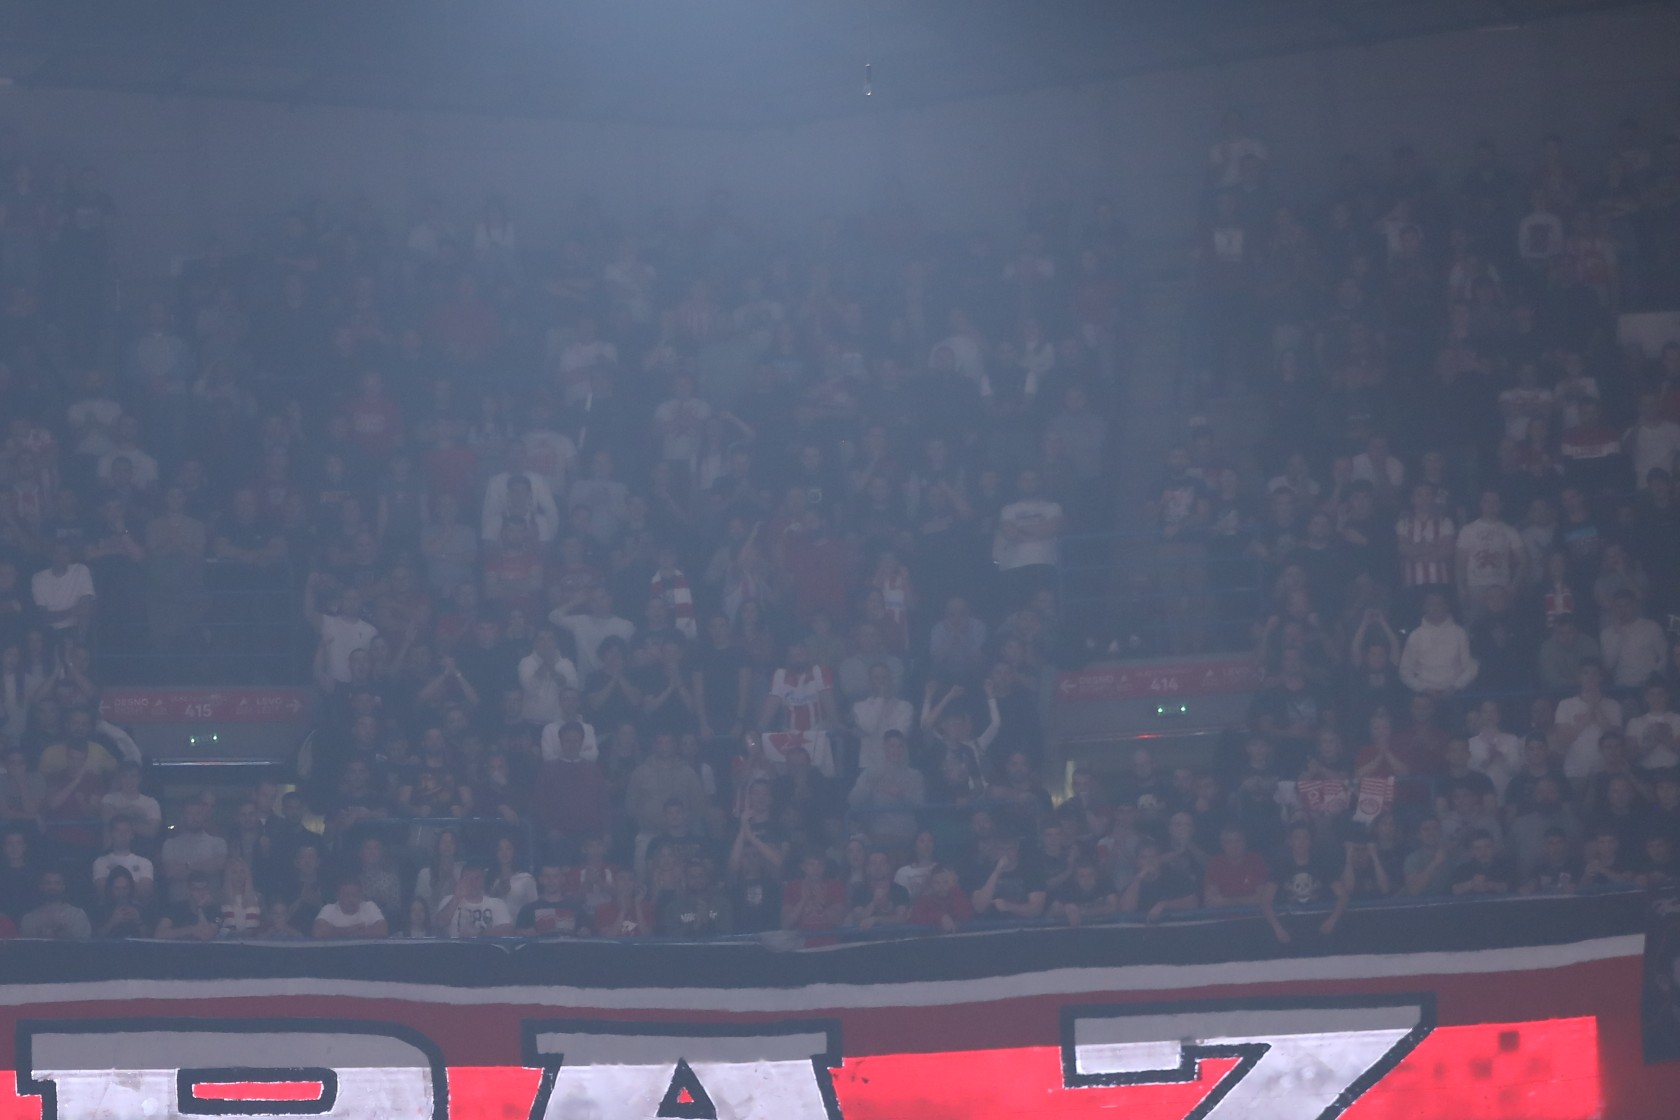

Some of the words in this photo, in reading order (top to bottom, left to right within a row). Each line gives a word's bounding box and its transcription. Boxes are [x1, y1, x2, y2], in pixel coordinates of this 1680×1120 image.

[1149, 677, 1180, 692] 414
[114, 698, 150, 707] DESNO
[184, 704, 214, 719] 415
